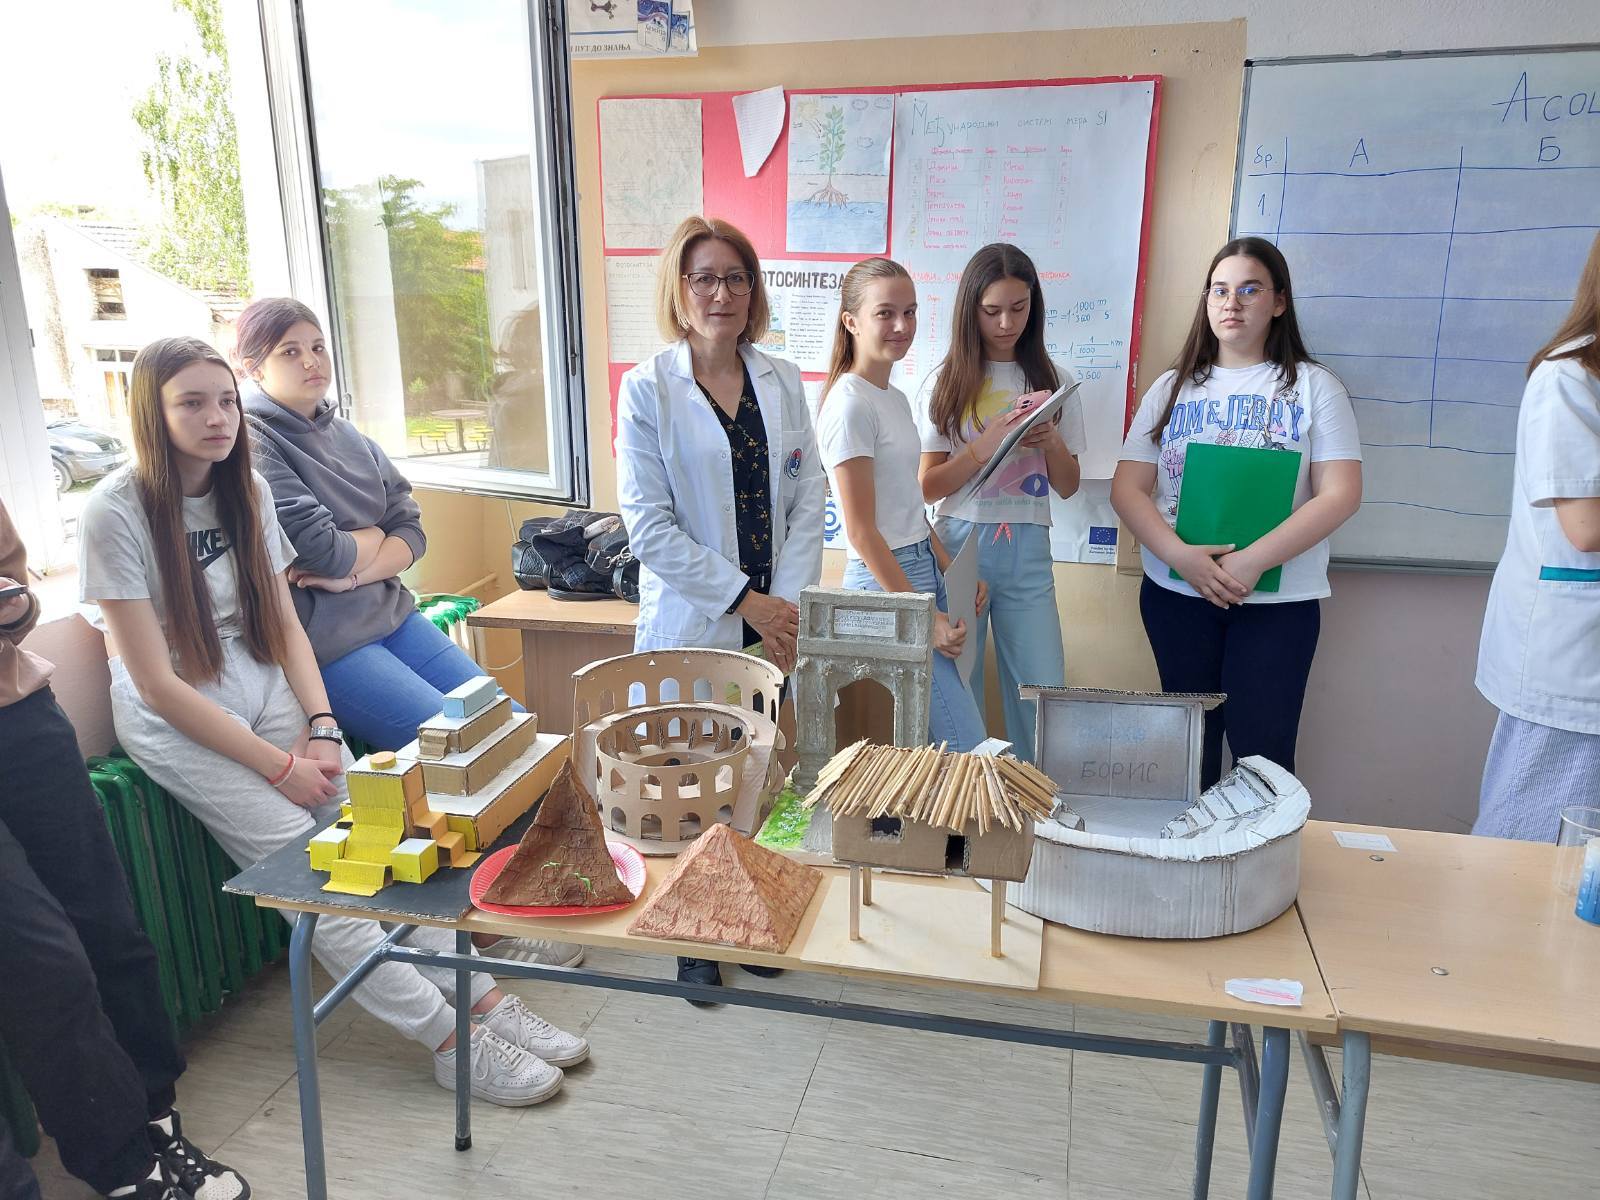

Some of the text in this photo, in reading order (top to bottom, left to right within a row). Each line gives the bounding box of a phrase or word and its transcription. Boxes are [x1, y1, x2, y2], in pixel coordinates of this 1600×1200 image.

[574, 44, 590, 53] ПУТ
[591, 44, 602, 53] ДО
[603, 43, 631, 52] ЗНАЊА
[1349, 137, 1369, 168] А
[1537, 135, 1561, 163] Б
[1161, 397, 1208, 445] OM
[186, 527, 223, 557] IKE
[1080, 760, 1159, 783] БОРИС
